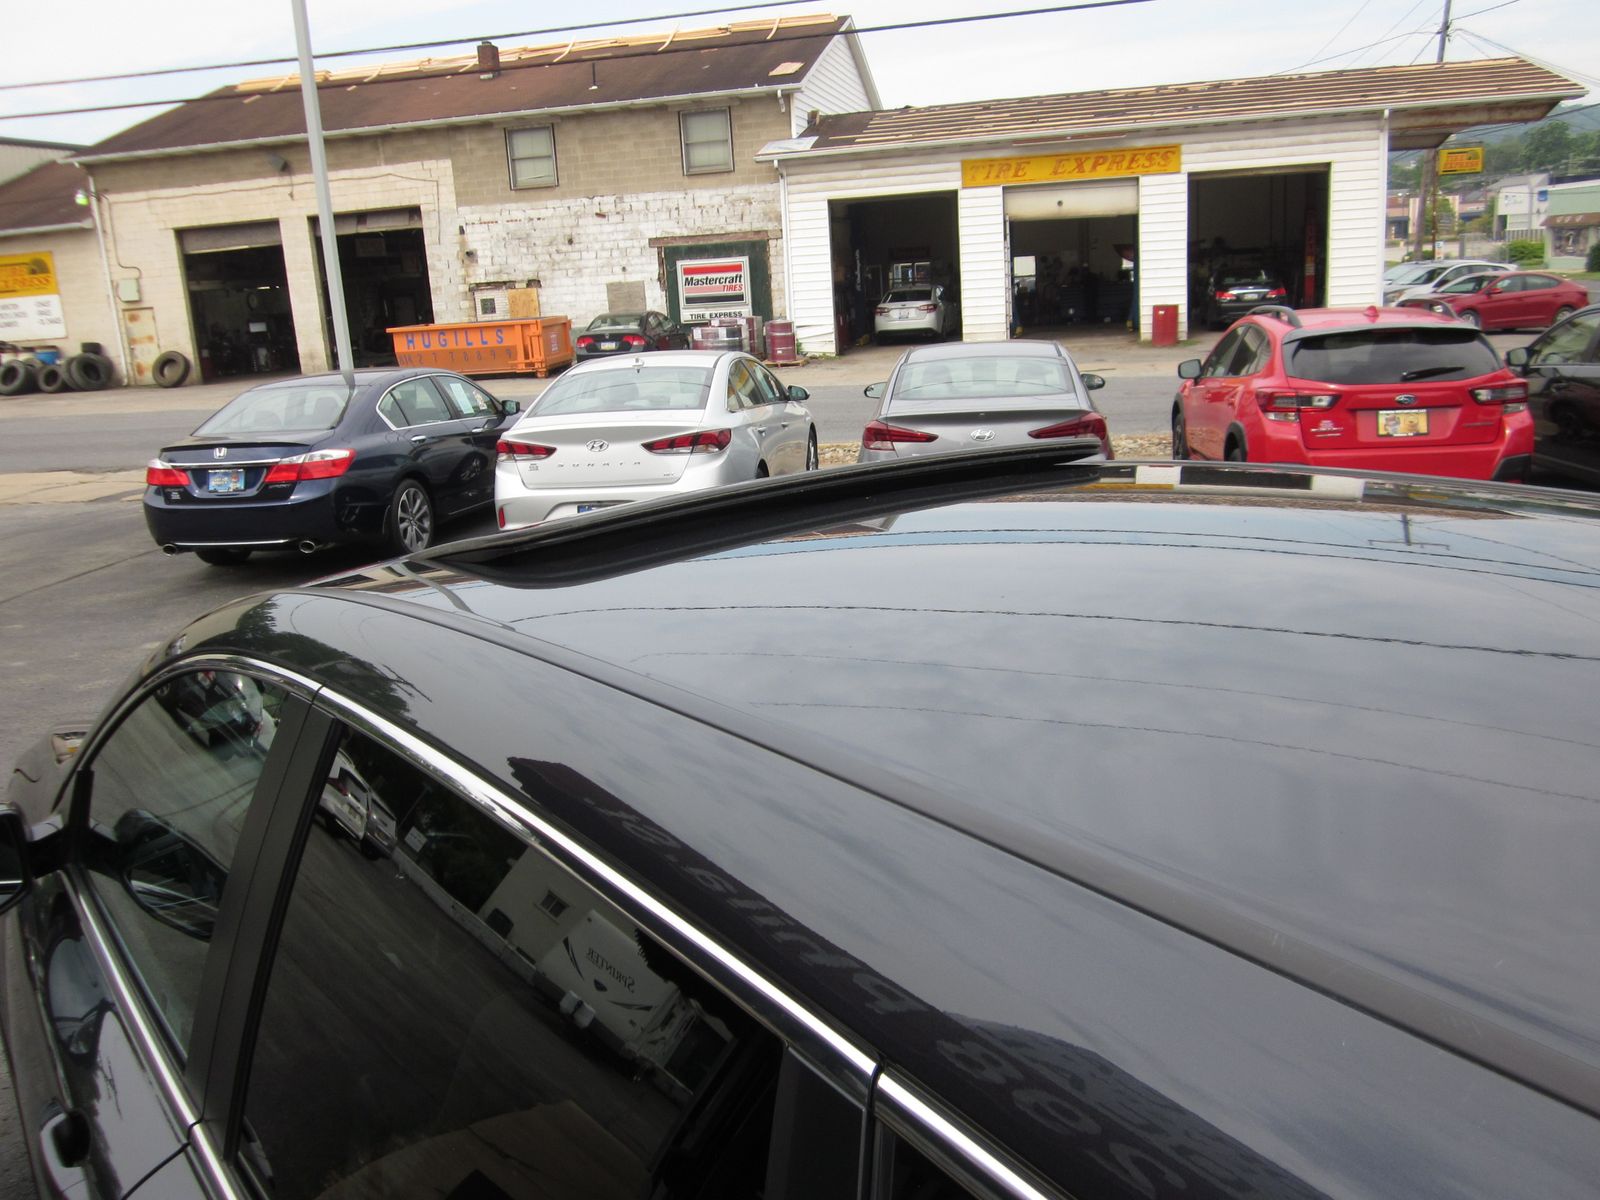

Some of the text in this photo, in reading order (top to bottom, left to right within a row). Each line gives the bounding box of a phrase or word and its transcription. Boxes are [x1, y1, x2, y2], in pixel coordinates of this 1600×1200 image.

[969, 150, 1177, 182] TIRE EXPRESS
[684, 274, 743, 287] Mastercraft
[722, 284, 743, 292] TIRES
[690, 310, 743, 320] TIRE EXPRESS
[405, 328, 504, 350] HUGILLS
